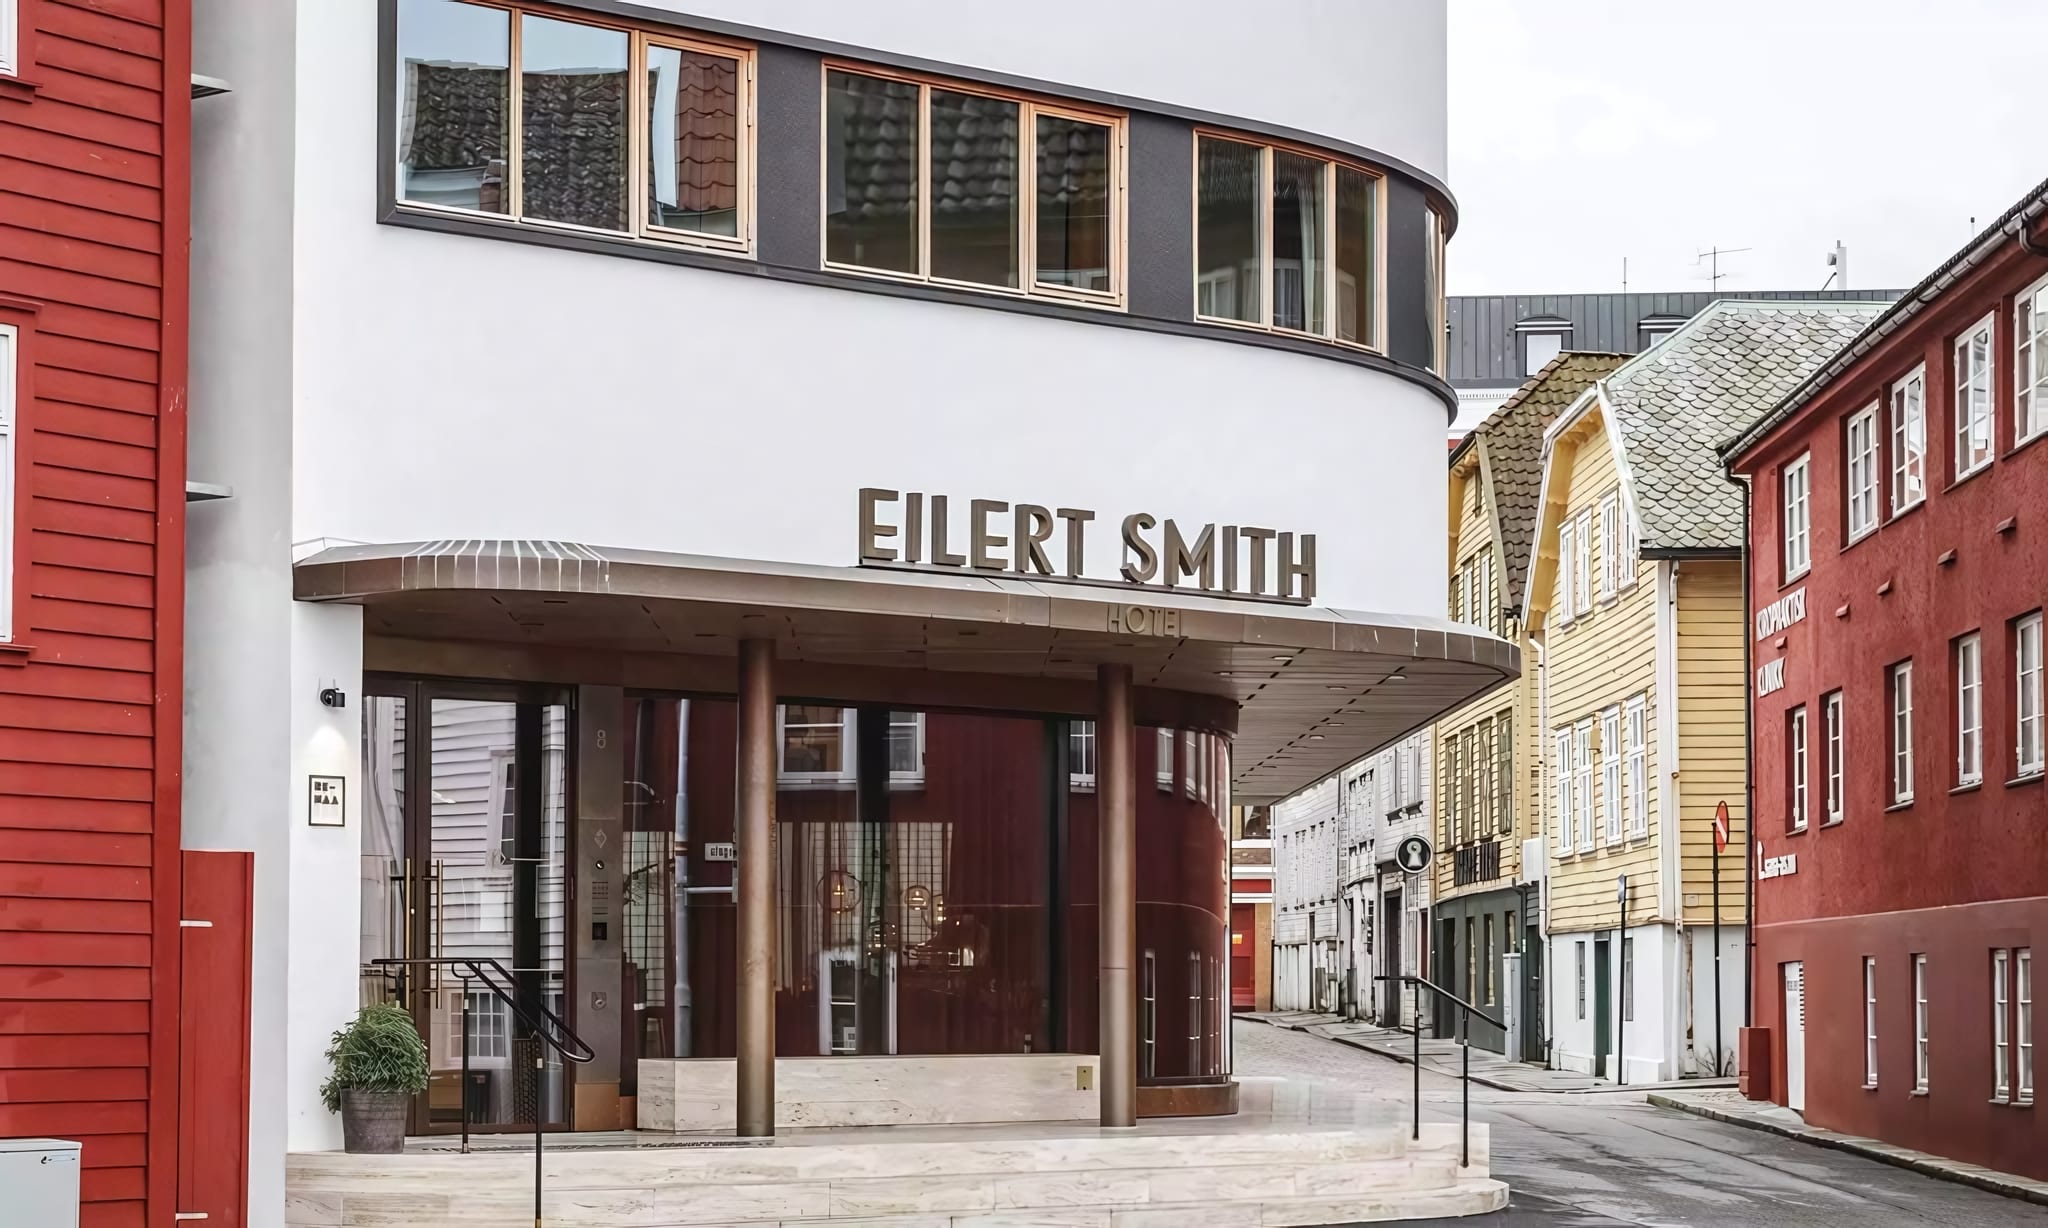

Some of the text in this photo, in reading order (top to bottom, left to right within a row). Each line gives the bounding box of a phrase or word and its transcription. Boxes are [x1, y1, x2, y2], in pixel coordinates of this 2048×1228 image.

[859, 488, 1317, 599] EILERT SMITH
[1106, 602, 1188, 639] HOTEL
